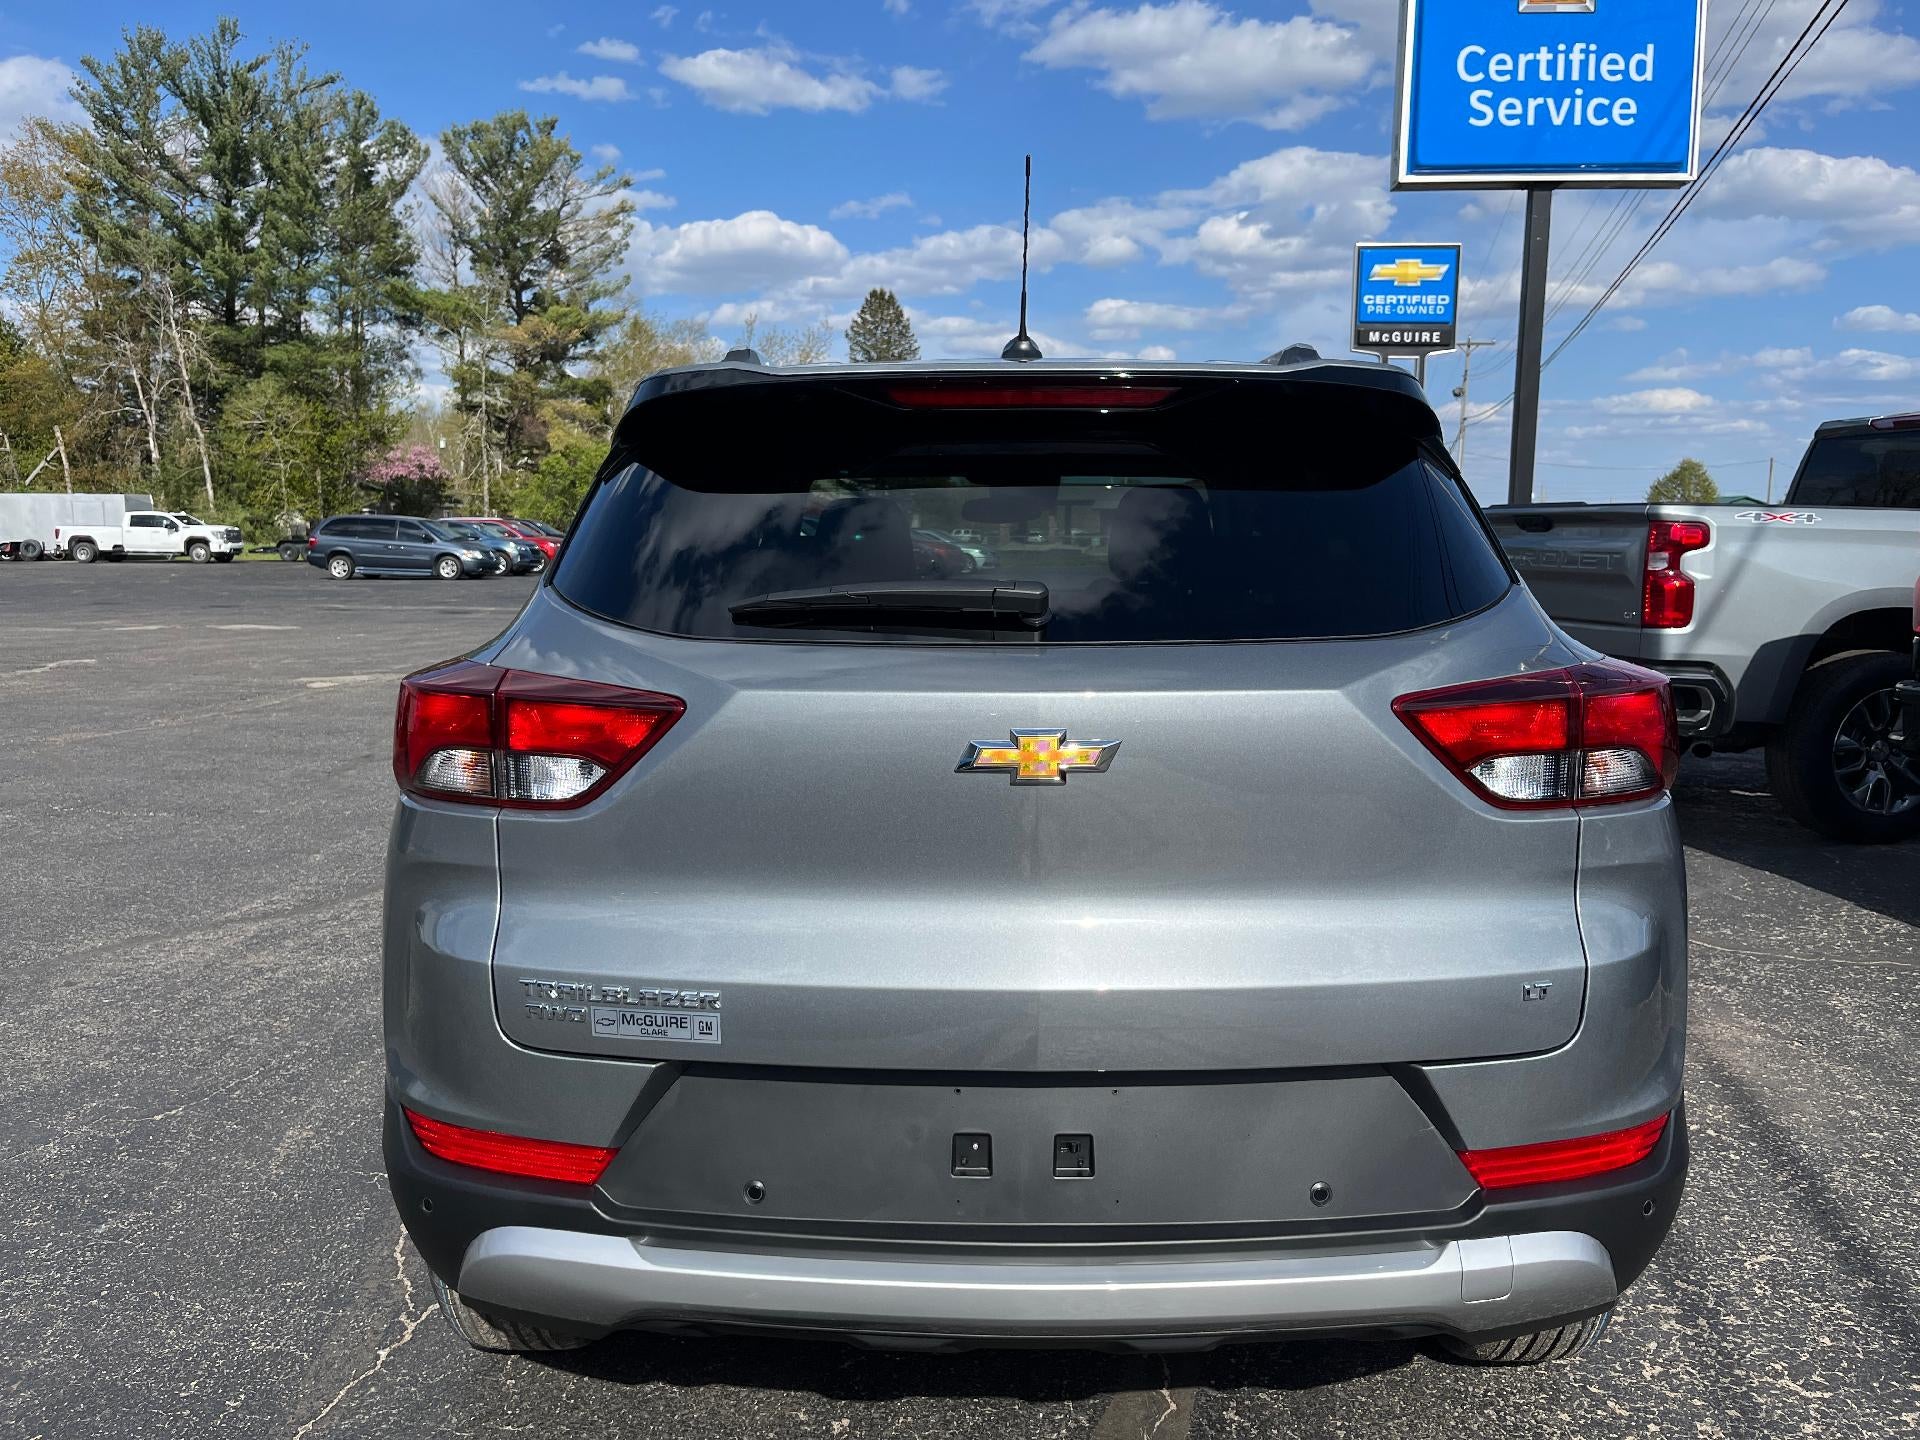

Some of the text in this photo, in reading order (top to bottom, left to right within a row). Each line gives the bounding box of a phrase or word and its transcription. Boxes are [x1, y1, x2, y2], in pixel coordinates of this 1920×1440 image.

[1456, 43, 1654, 82] Certified
[1468, 88, 1637, 127] Service
[1363, 295, 1450, 305] CERTIFIED
[1367, 305, 1445, 315] PRE-OWNED
[1369, 332, 1441, 343] McGUIRE
[518, 977, 722, 1009] TRAILBLAZER
[1522, 980, 1553, 1001] LT
[621, 1013, 688, 1029] McGUIRE
[698, 1021, 713, 1033] GM
[640, 1027, 669, 1037] CLARE
